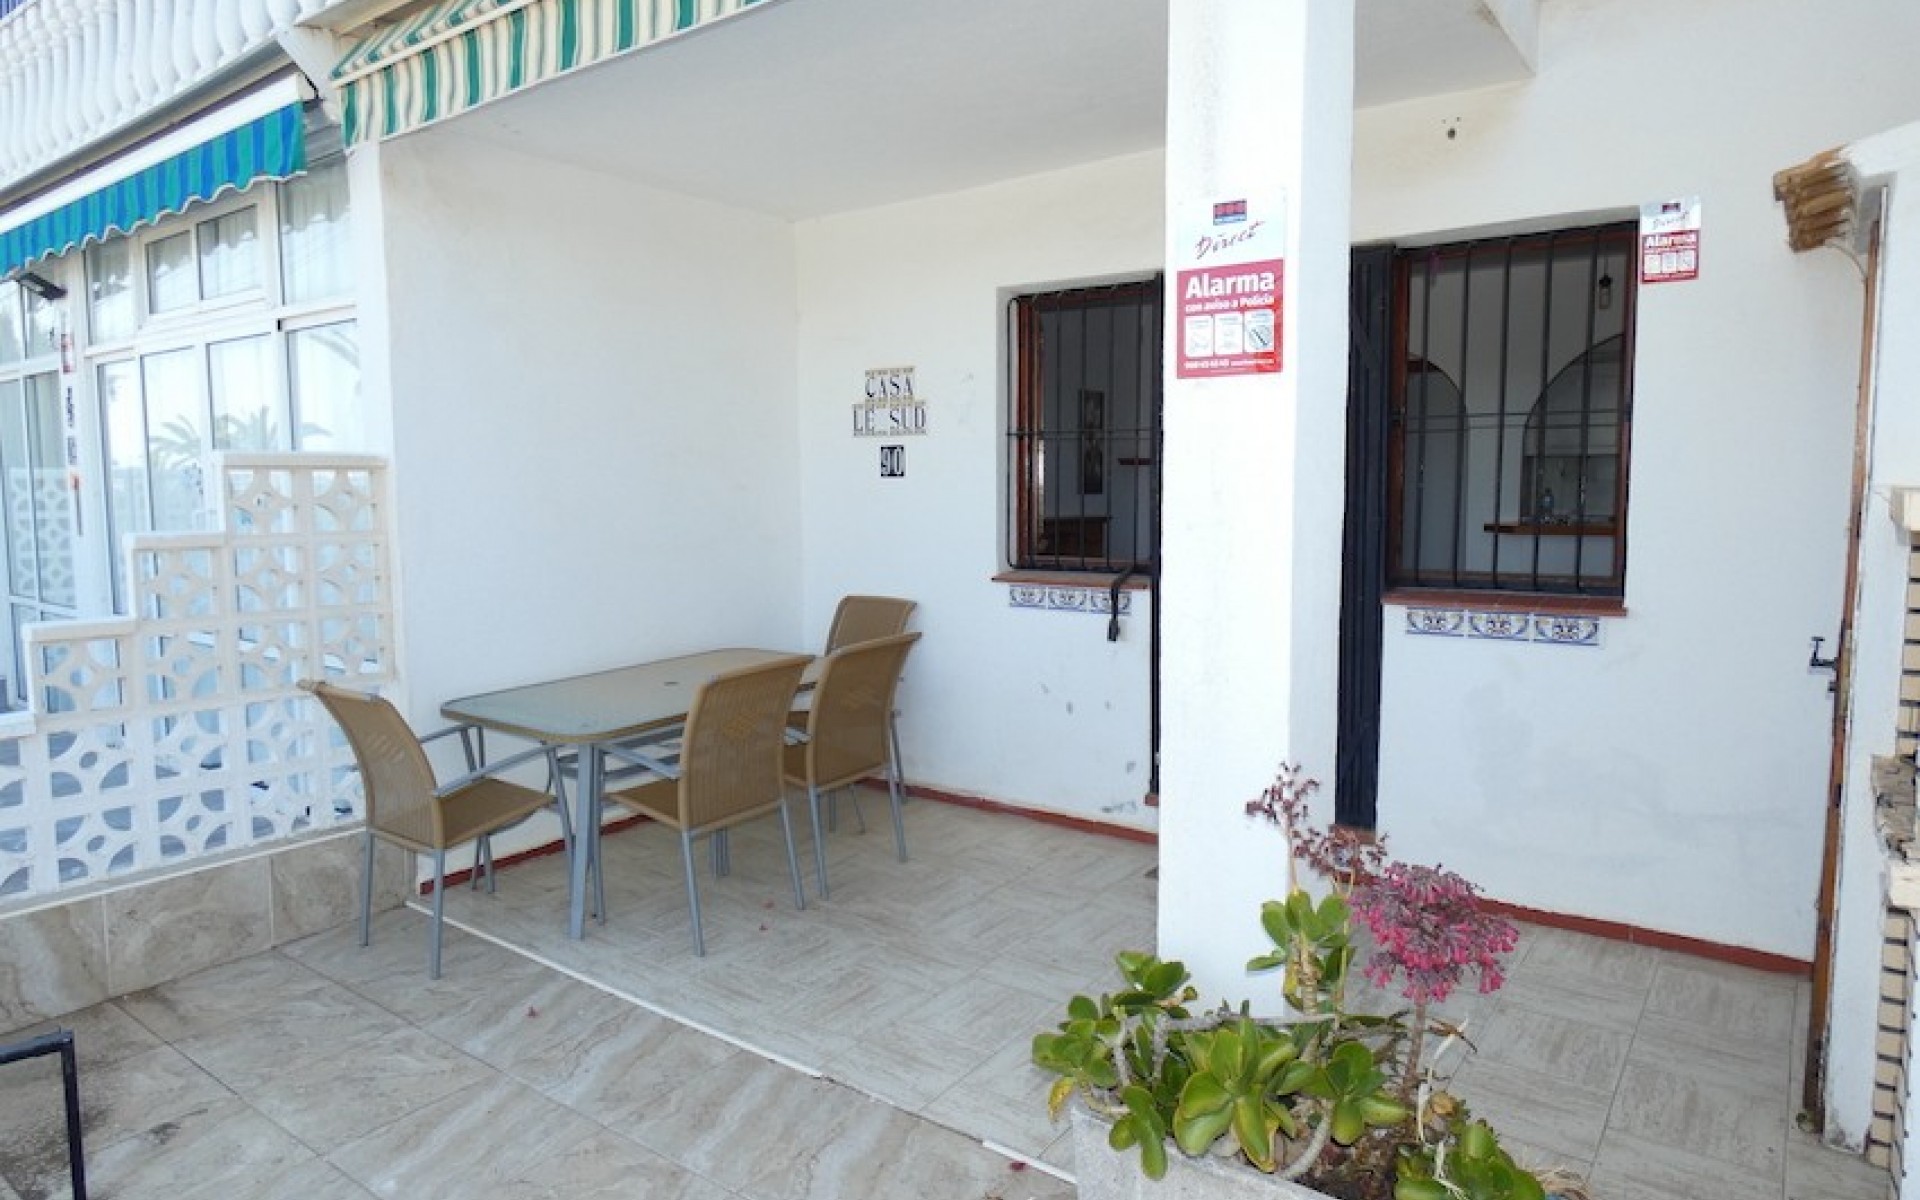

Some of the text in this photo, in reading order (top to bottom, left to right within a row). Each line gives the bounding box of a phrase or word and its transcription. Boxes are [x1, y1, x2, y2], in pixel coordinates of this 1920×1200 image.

[1195, 220, 1266, 259] Direct
[1645, 232, 1696, 247] Alarma
[1185, 271, 1275, 299] Alarma
[864, 374, 913, 398] CASA
[852, 405, 927, 431] LE SUD
[880, 446, 905, 476] 90
